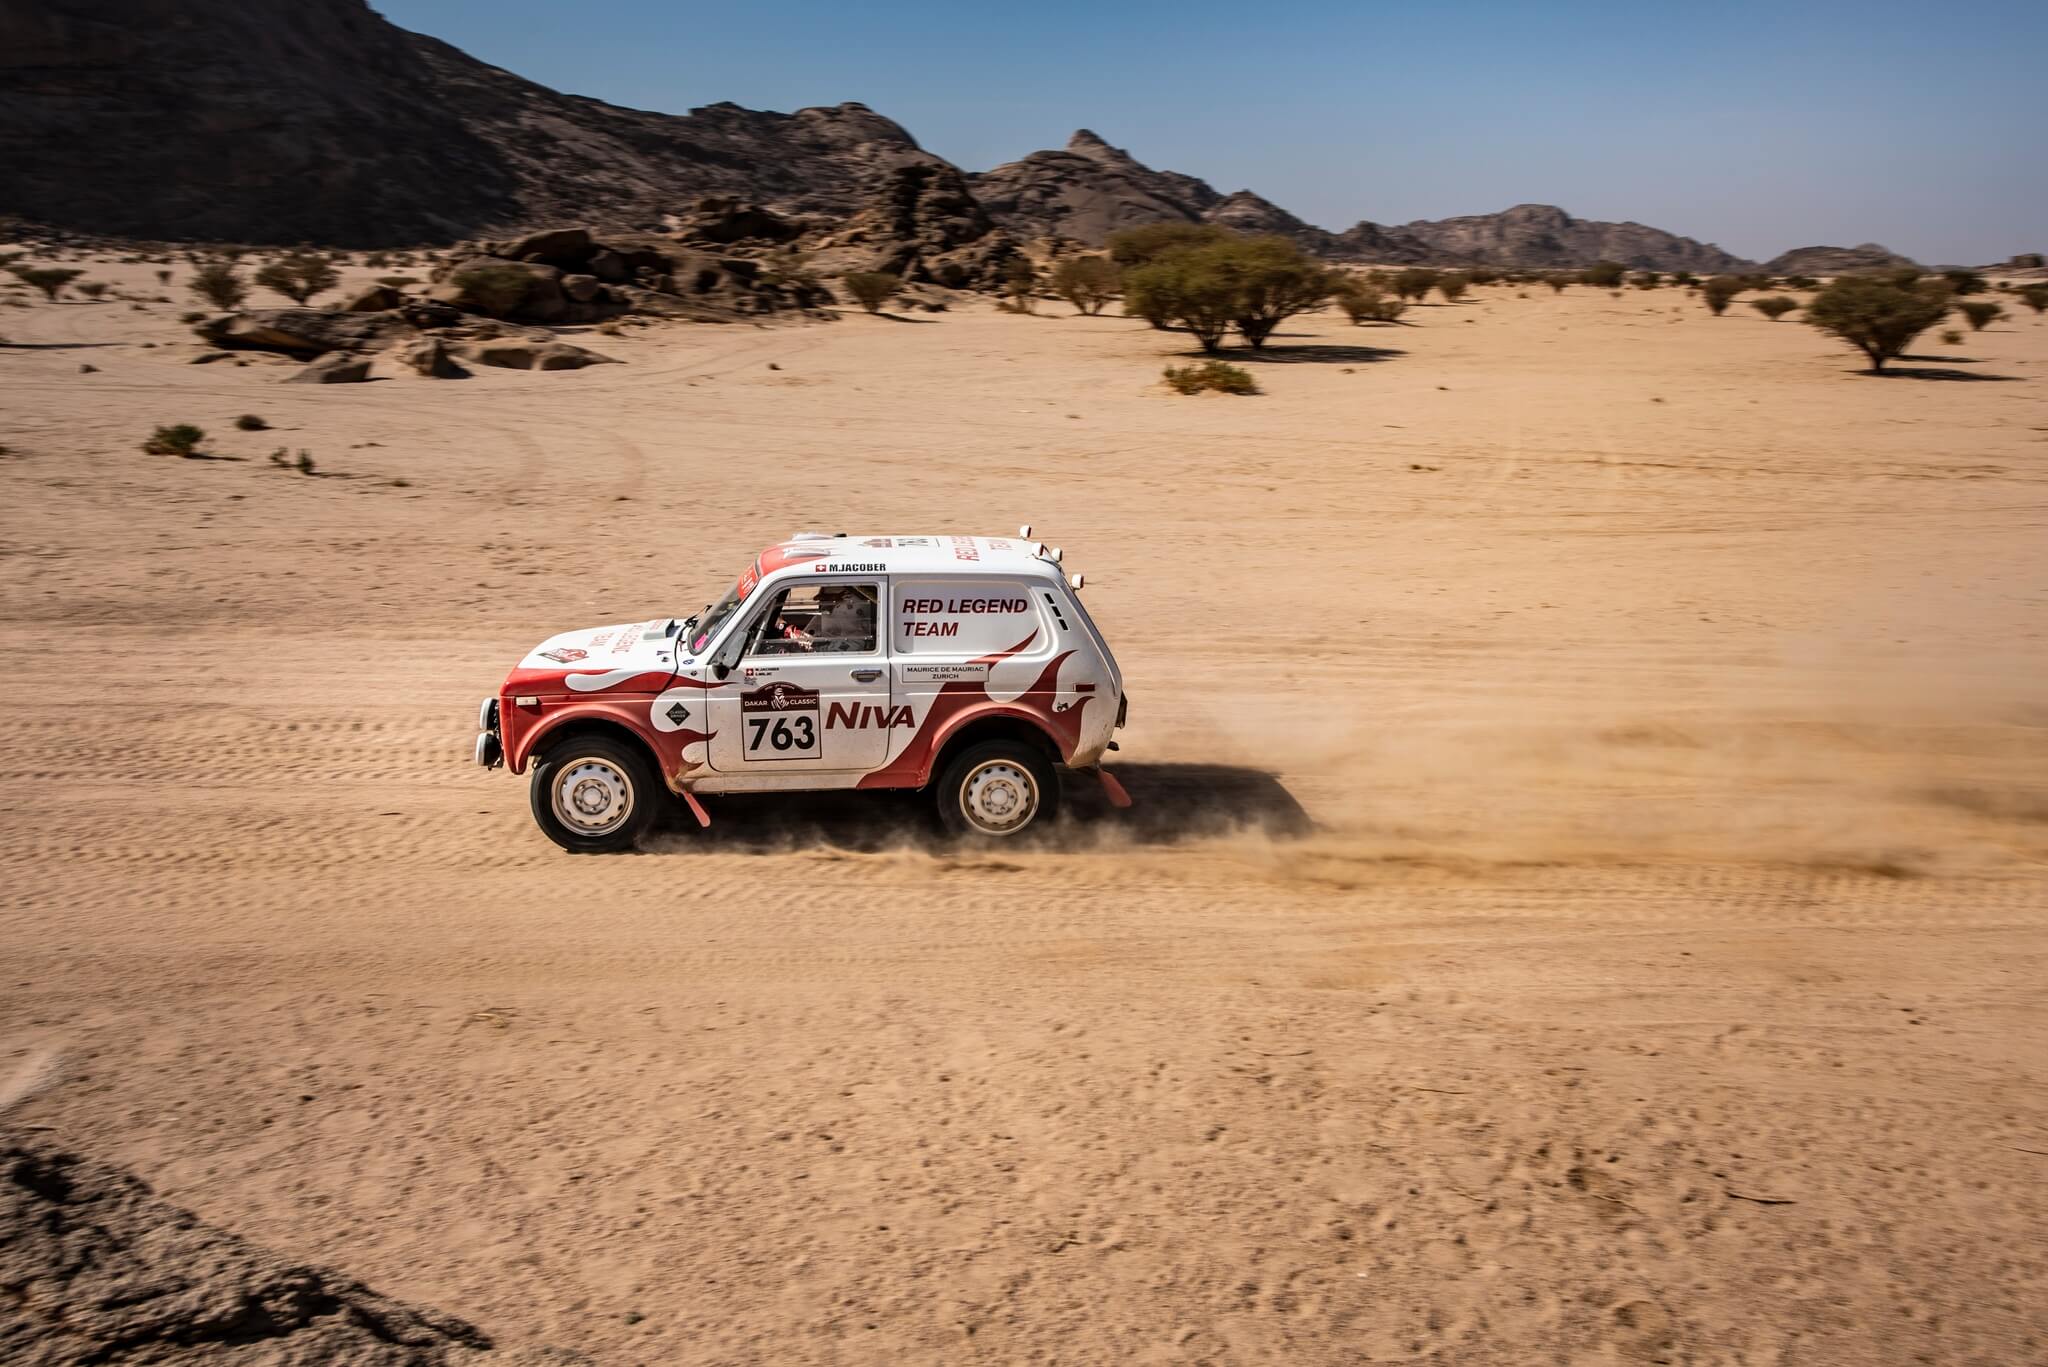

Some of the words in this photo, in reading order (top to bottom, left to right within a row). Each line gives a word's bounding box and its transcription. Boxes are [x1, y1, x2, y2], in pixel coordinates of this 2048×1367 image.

[829, 563, 887, 572] M.JACOBER
[902, 599, 943, 614] RED
[947, 599, 1028, 614] LEGEND
[903, 622, 959, 637] TEAM
[748, 716, 815, 751] 763
